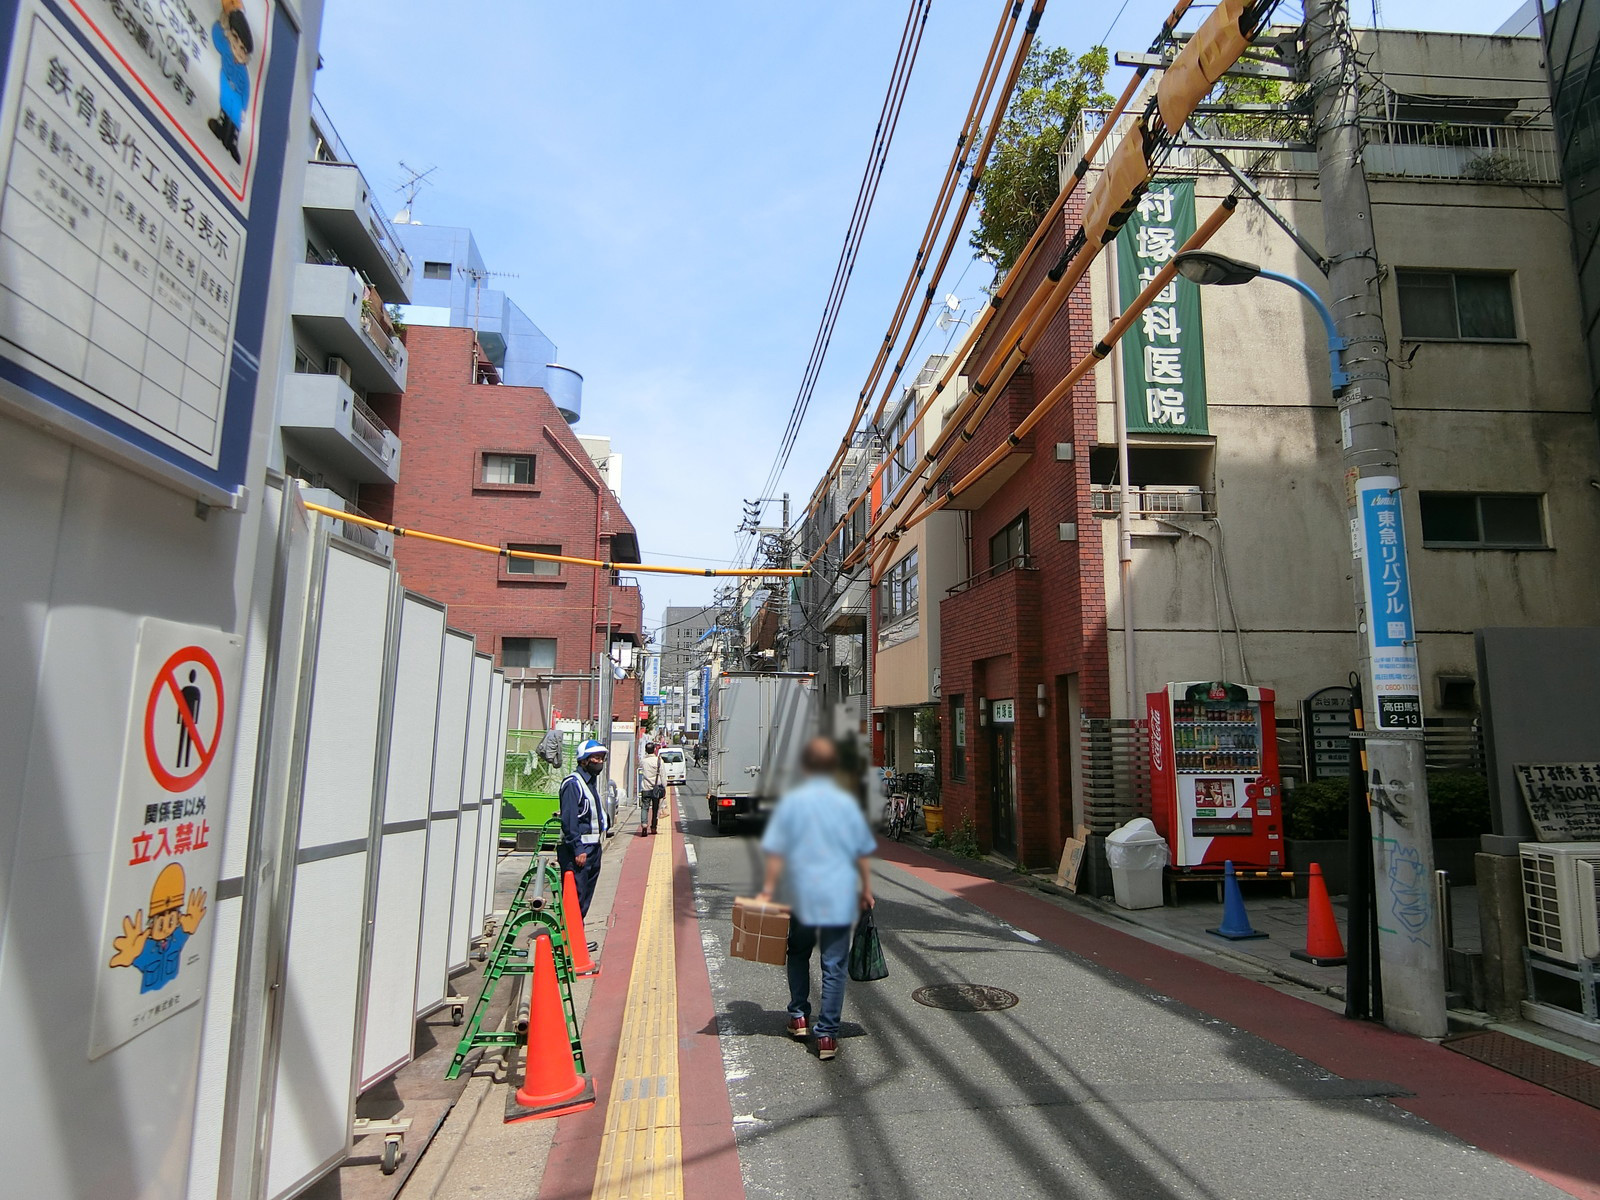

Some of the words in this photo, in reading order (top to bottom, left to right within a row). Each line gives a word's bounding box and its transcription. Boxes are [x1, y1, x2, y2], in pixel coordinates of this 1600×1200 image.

[47, 57, 228, 260] 鉄骨製作工場名表示
[1136, 188, 1185, 425] 村塚歯科医院
[1377, 511, 1404, 614] 東急リバブル
[1390, 714, 1417, 724] 2-13
[128, 819, 210, 866] 立入禁止
[144, 796, 206, 825] 関係者以外
